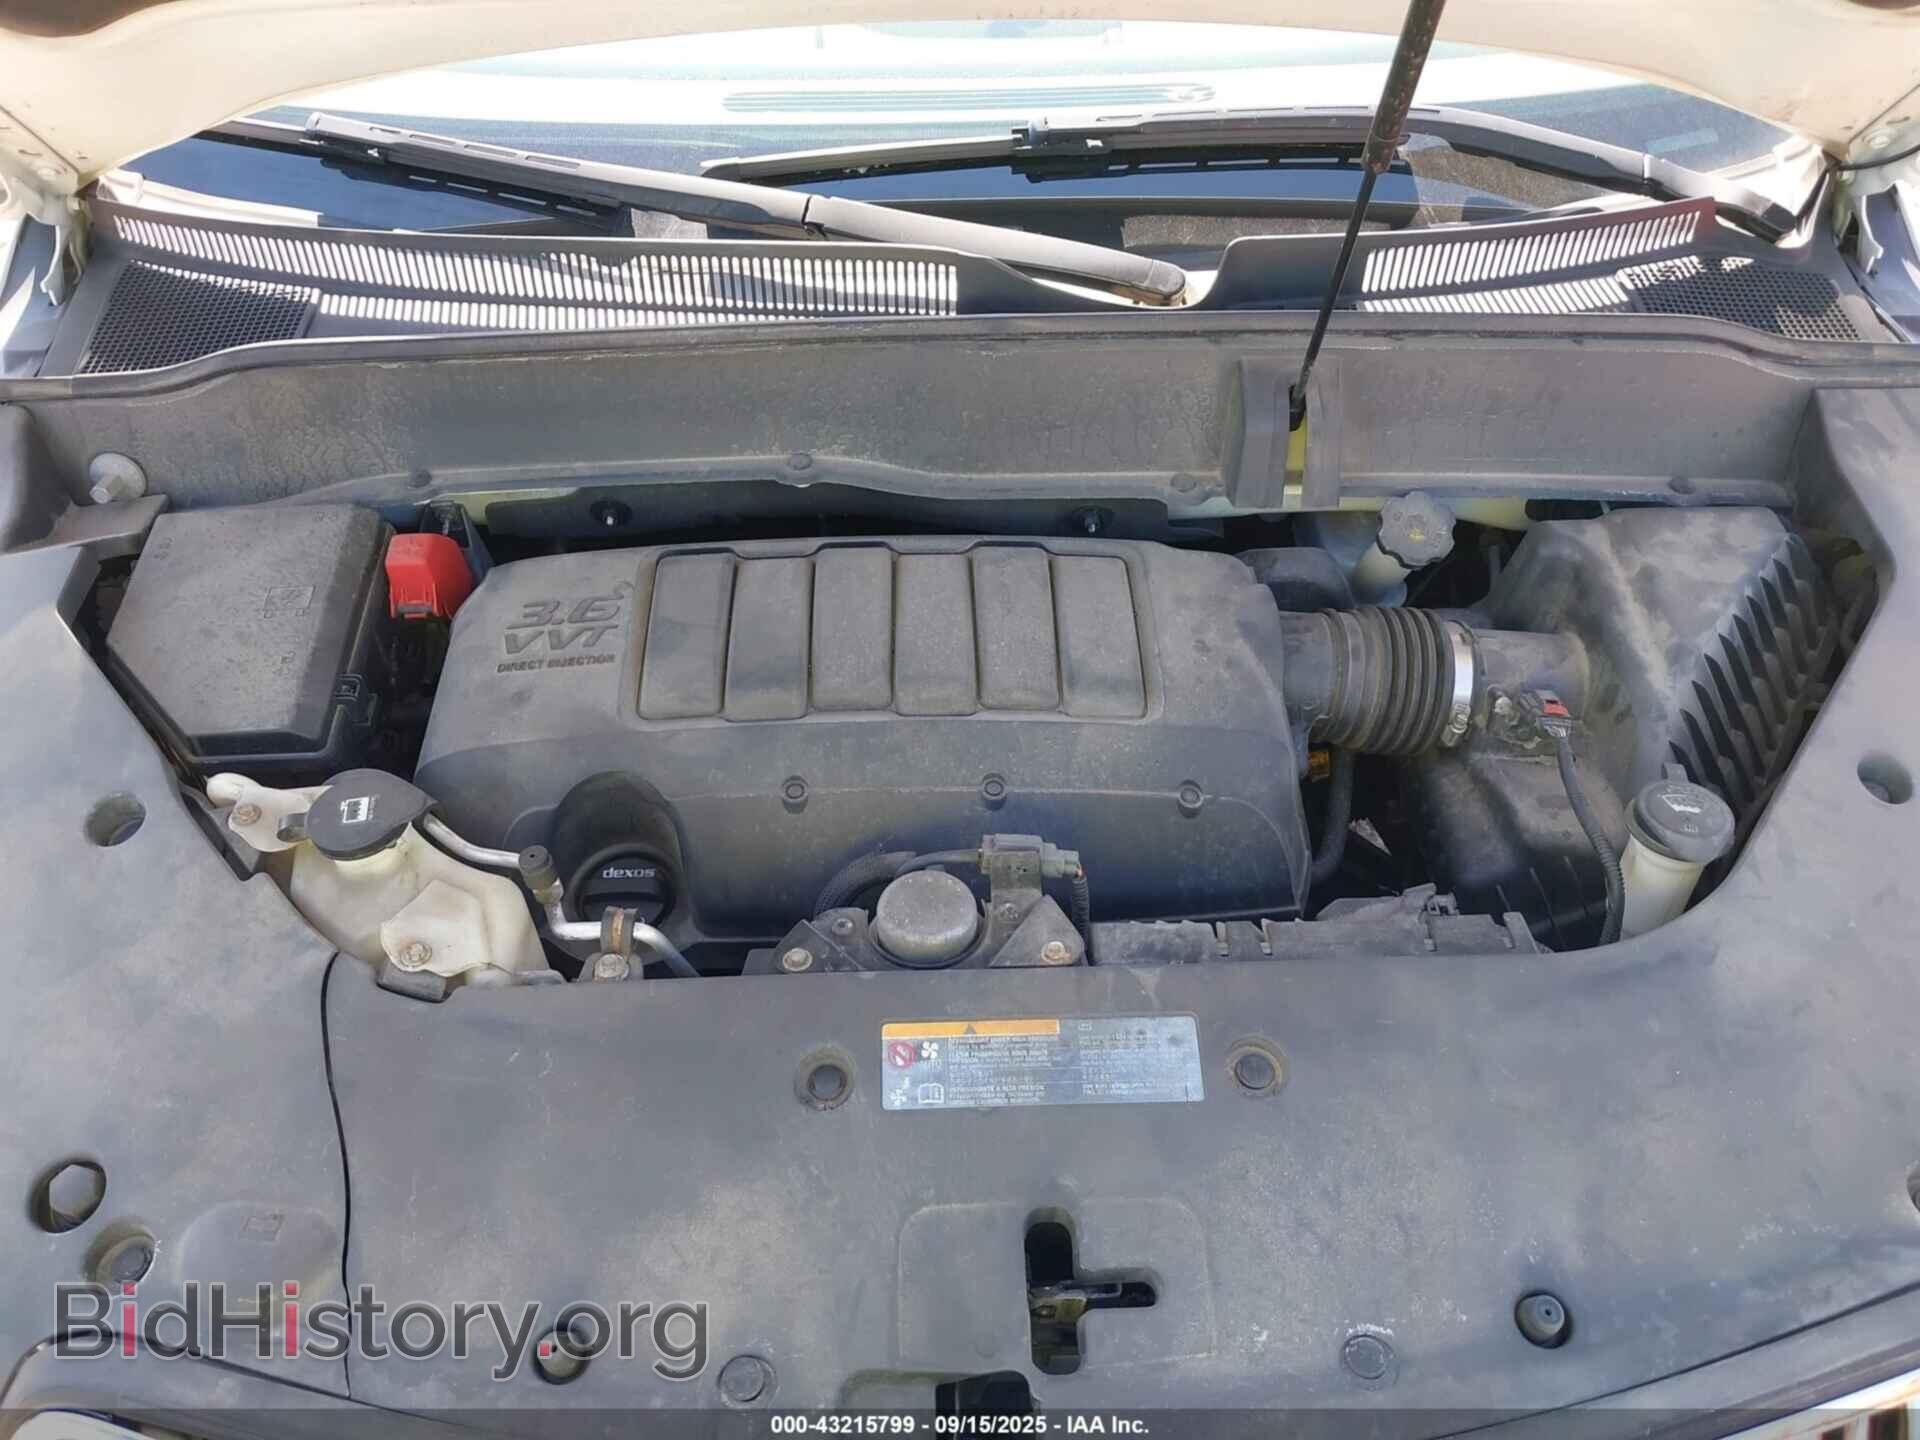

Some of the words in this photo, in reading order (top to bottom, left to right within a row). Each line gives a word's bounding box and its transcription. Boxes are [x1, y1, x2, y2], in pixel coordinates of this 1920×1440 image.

[505, 593, 625, 630] 3.6
[504, 624, 619, 654] VVT
[497, 659, 544, 673] DIRECT
[547, 653, 616, 669] INJECTION
[602, 866, 656, 879] dexos
